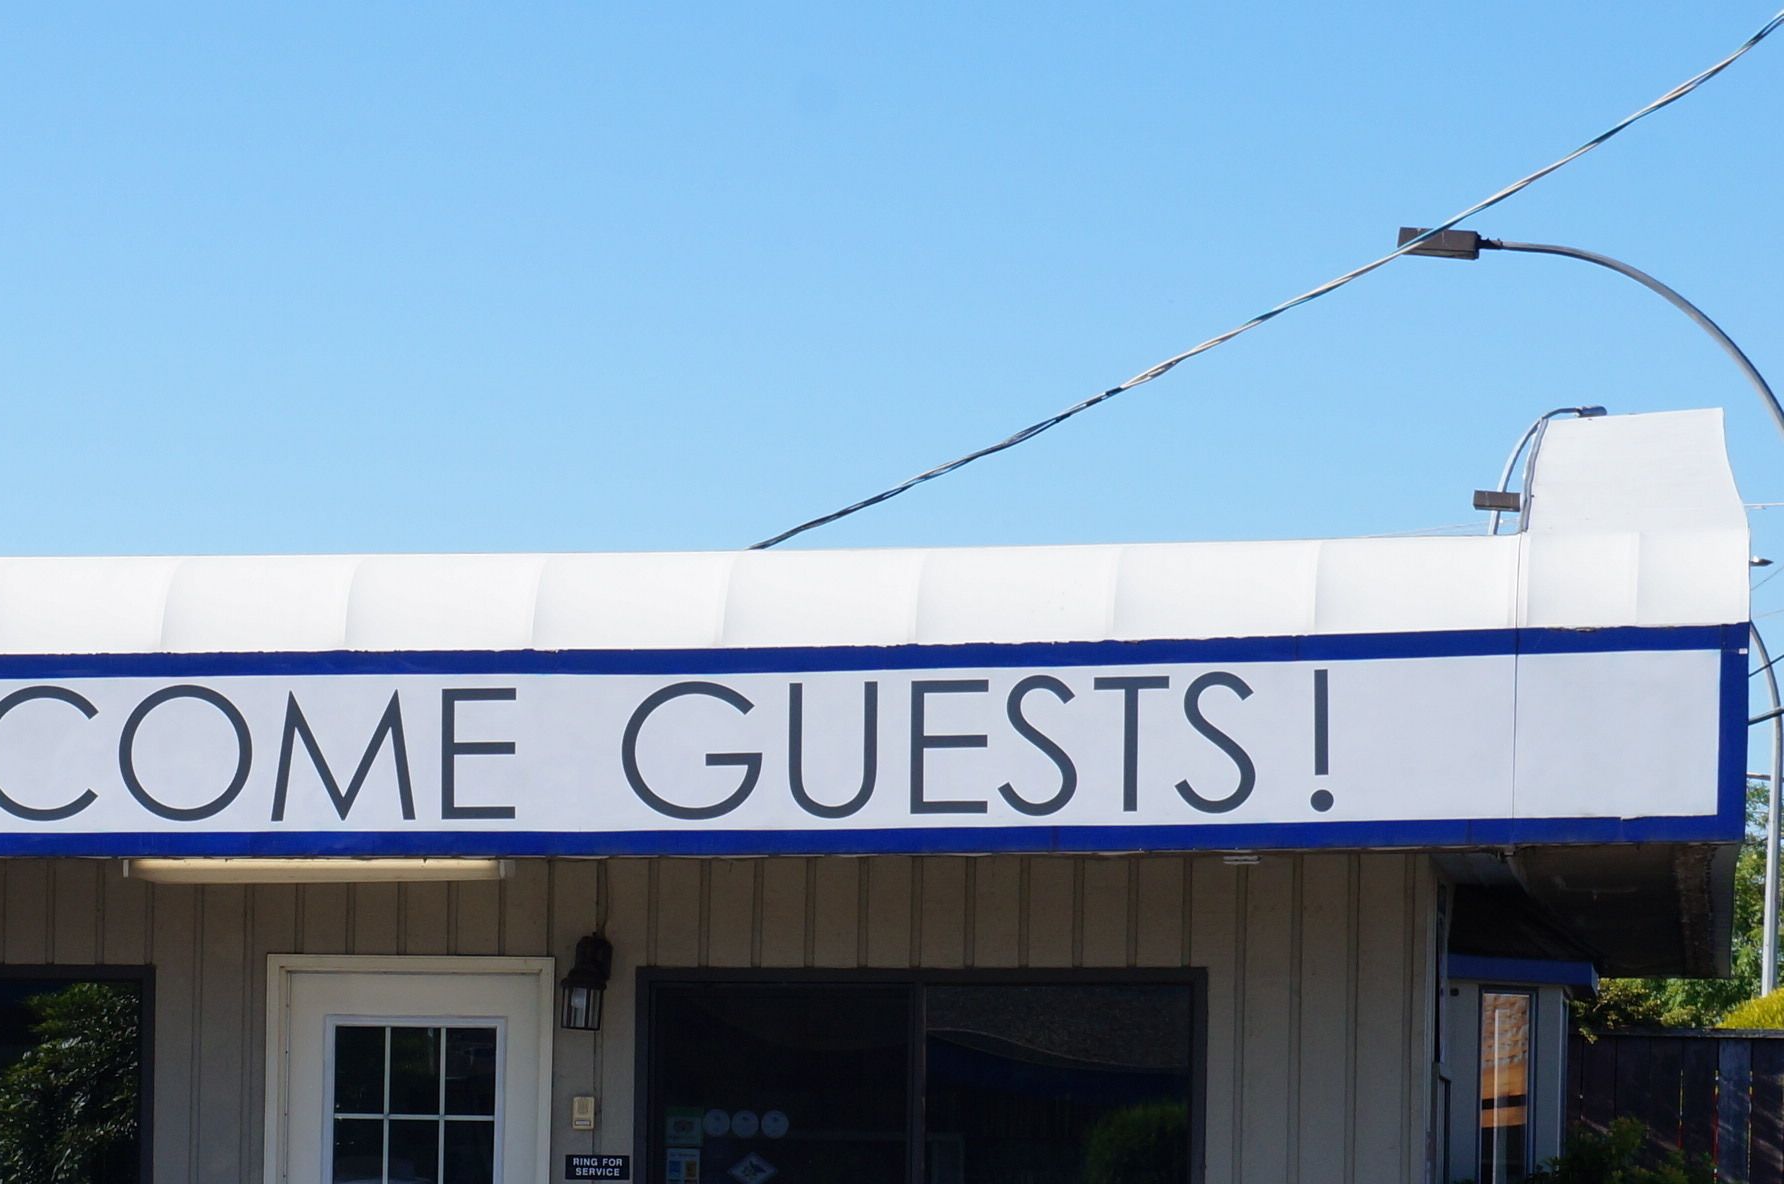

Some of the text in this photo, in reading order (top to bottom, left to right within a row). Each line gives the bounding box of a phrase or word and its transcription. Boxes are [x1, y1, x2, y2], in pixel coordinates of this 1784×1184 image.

[621, 668, 1335, 820] GUESTS!
[573, 1157, 623, 1167] RING FOR
[575, 1167, 620, 1176] SERVICE
